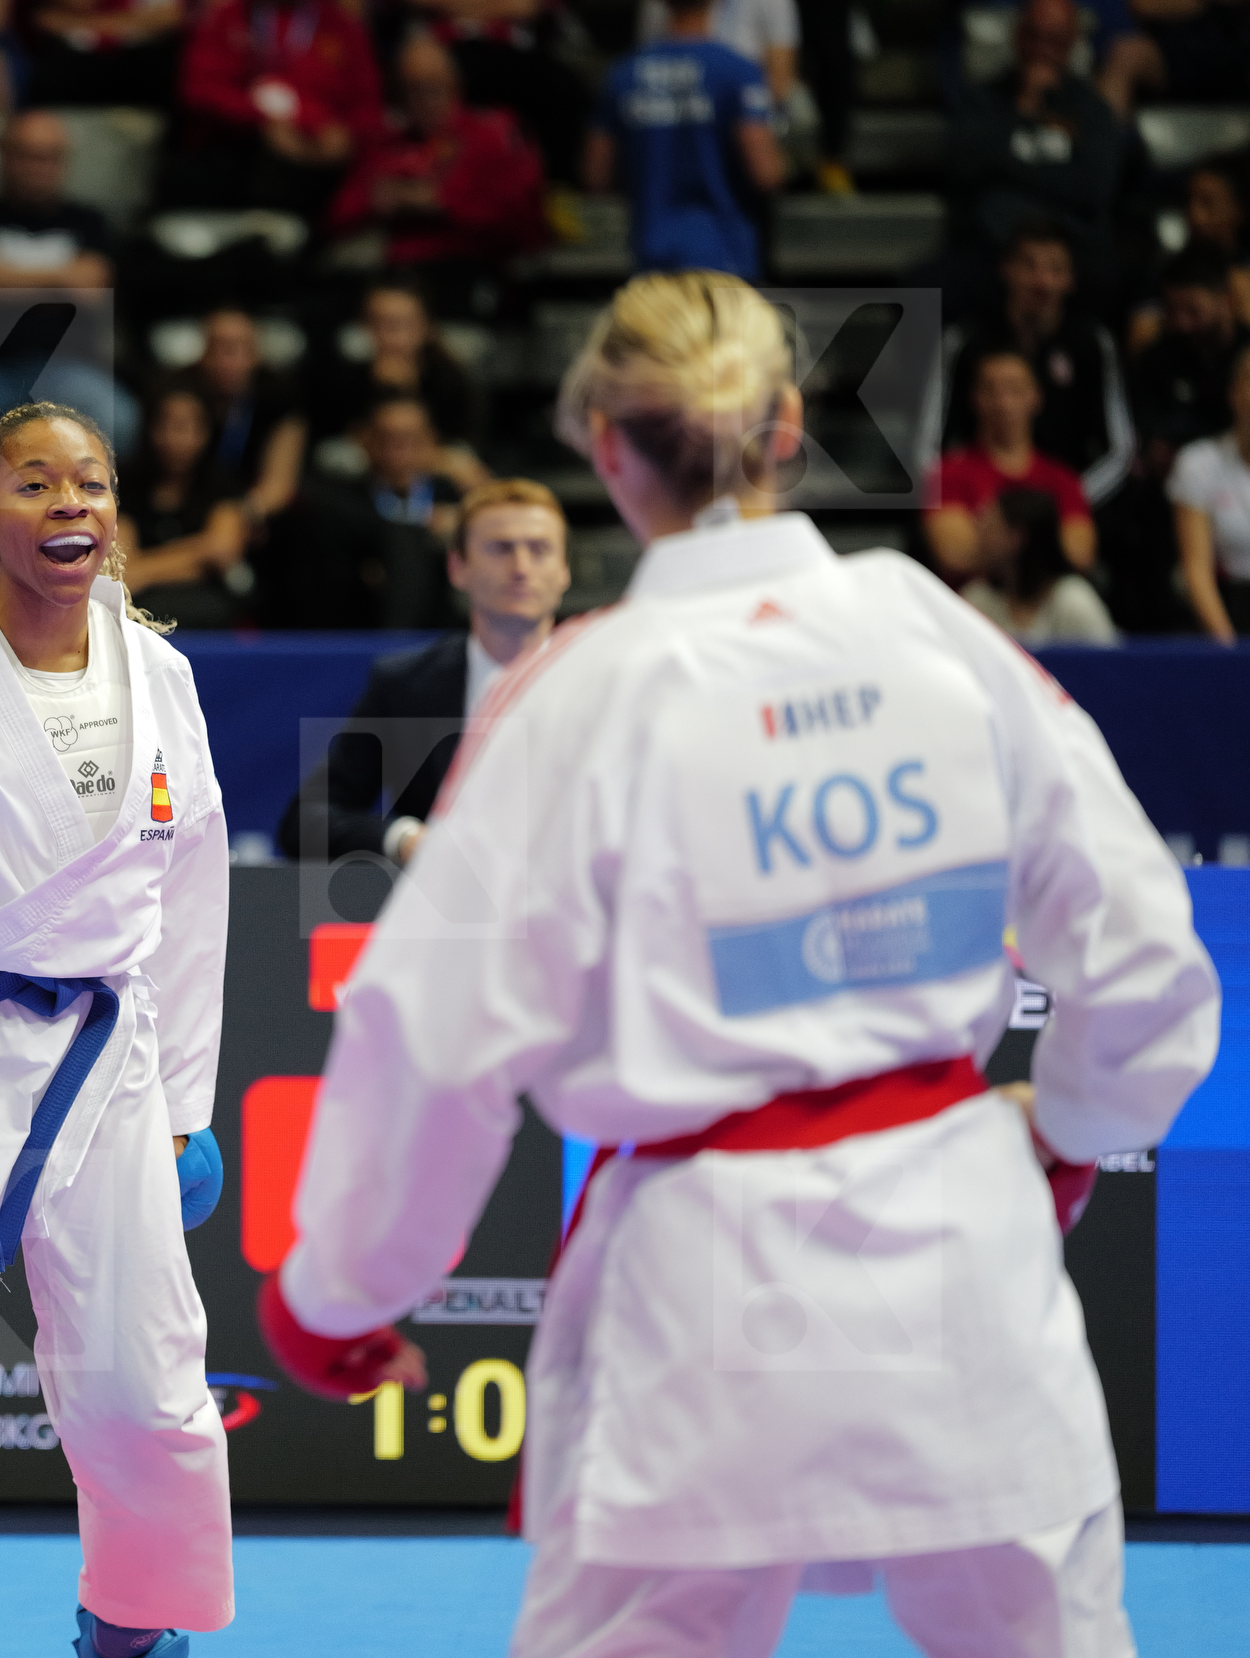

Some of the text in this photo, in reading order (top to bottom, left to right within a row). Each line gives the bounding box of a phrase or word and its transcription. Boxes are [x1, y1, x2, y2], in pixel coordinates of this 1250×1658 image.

[78, 717, 118, 731] APPROVED
[50, 728, 71, 739] WKF
[744, 760, 940, 875] KOS
[140, 826, 175, 841] ESPAÑ
